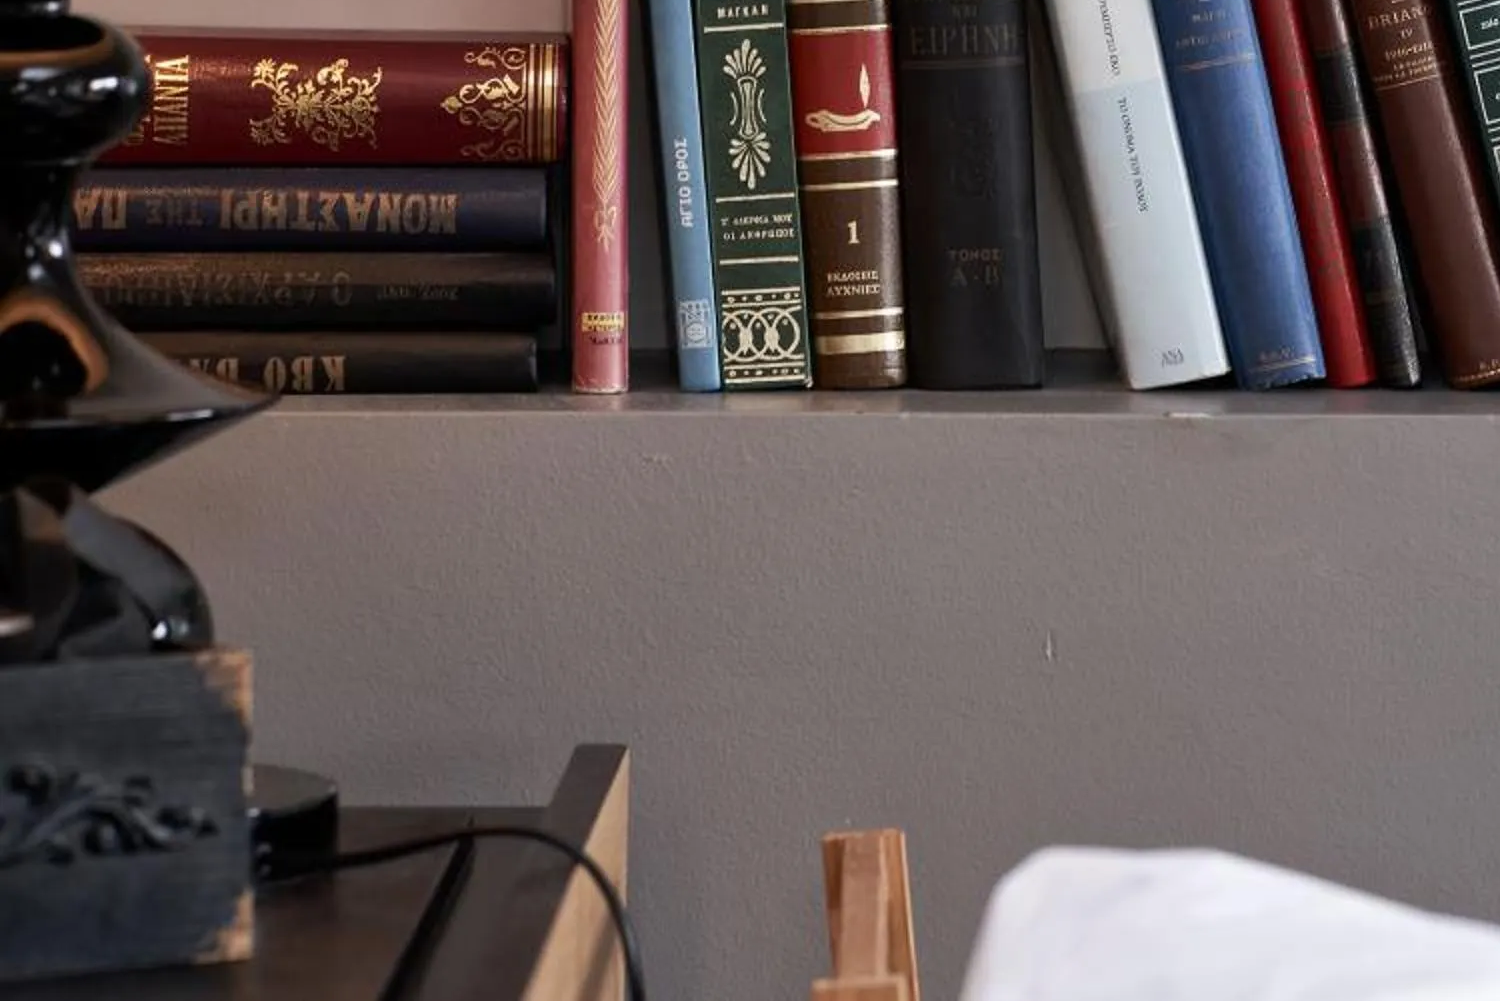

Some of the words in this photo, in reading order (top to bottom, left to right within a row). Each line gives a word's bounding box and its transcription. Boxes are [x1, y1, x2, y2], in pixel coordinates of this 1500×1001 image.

[909, 23, 1018, 55] ΕΙΡΗΝΗ
[1401, 29, 1413, 39] IV
[152, 54, 190, 146] ΑΠΑΝΤΑ
[673, 137, 691, 182] ΟΡΟΣ
[72, 189, 128, 232] ΠΑ
[145, 195, 204, 226] ΤΗΣ
[219, 189, 458, 235] ΜΟΝΑΣΤΗΡΙ
[678, 186, 694, 228] ΑΓΙΟ
[847, 220, 860, 245] 1
[945, 248, 1001, 262] ΤΟΜΟΣ
[263, 355, 346, 392] ΚΒΟ
